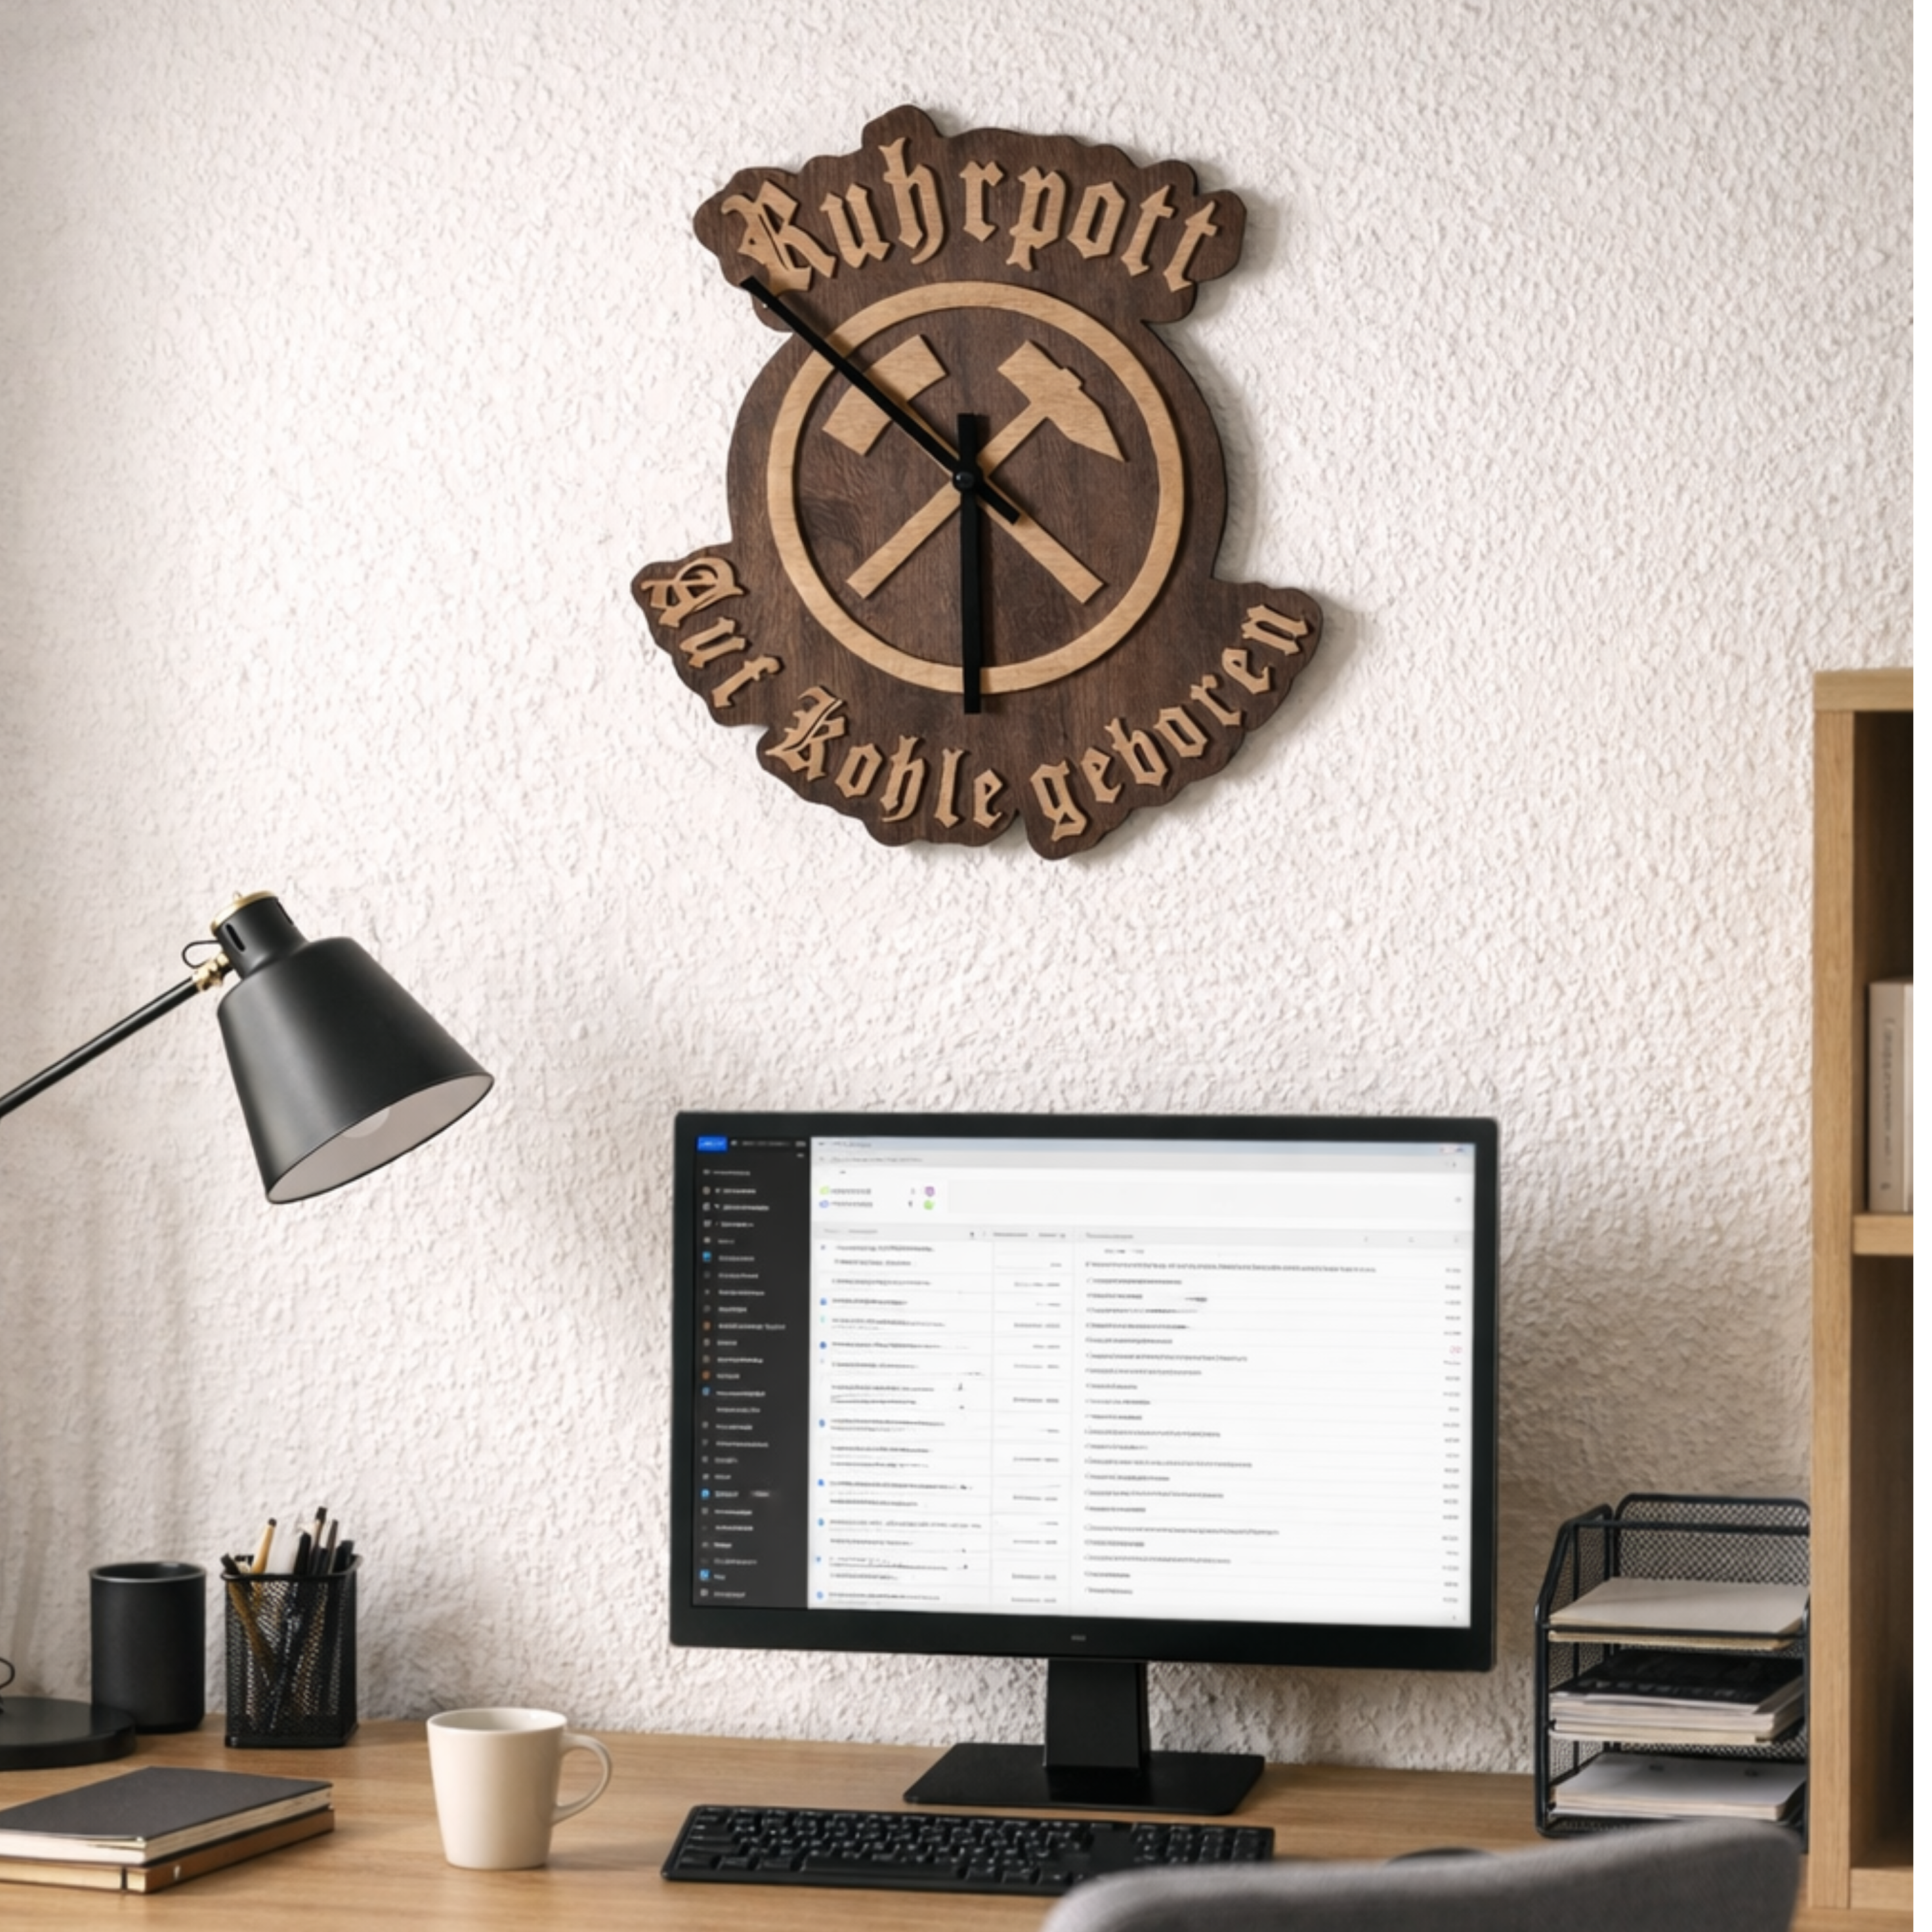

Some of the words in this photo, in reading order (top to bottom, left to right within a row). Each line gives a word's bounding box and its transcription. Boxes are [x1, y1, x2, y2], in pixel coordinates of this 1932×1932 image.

[721, 137, 1218, 292] Ruhrpott
[641, 557, 781, 707] Auf
[765, 686, 1003, 829] Kohle
[1031, 604, 1310, 841] geboren
